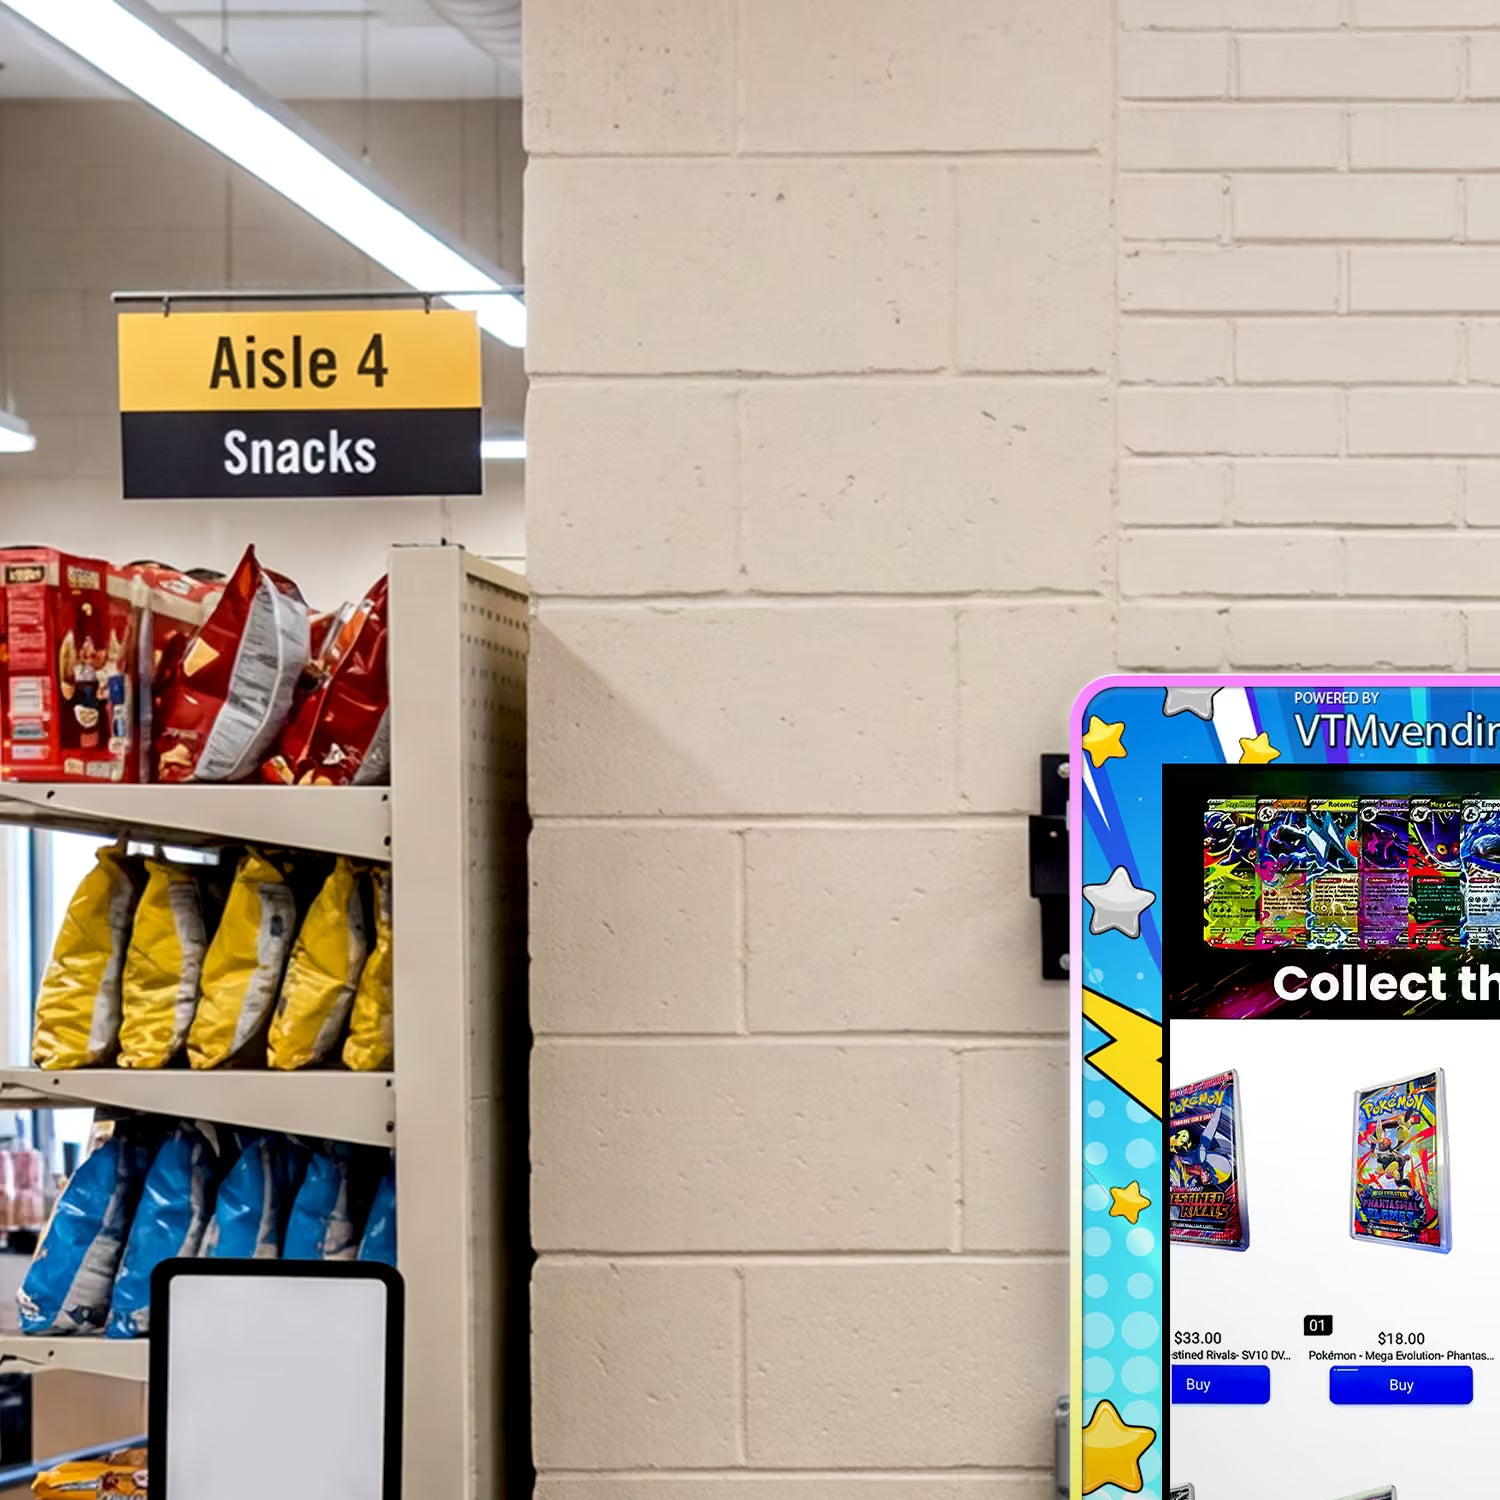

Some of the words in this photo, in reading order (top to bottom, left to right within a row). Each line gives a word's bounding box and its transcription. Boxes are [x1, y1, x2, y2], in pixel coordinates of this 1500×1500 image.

[209, 334, 337, 390] Aisle
[356, 333, 389, 388] 4
[224, 429, 377, 475] Snacks
[1294, 692, 1359, 705] POWERED
[1362, 692, 1380, 704] BY
[1273, 963, 1446, 1003] Collect
[1309, 1318, 1325, 1332] 01
[1174, 1330, 1222, 1345] $33.00
[1377, 1331, 1425, 1345] $18.00
[1171, 1350, 1204, 1361] stined
[1206, 1350, 1239, 1361] Rivals-
[1241, 1350, 1268, 1361] SV10
[1271, 1350, 1291, 1361] DV...
[1308, 1350, 1357, 1361] Pokémon
[1365, 1350, 1394, 1363] Mega
[1395, 1350, 1445, 1361] Evolution-
[1446, 1350, 1495, 1361] Phantas...
[1186, 1378, 1211, 1393] Buy
[1389, 1378, 1414, 1394] Buy
